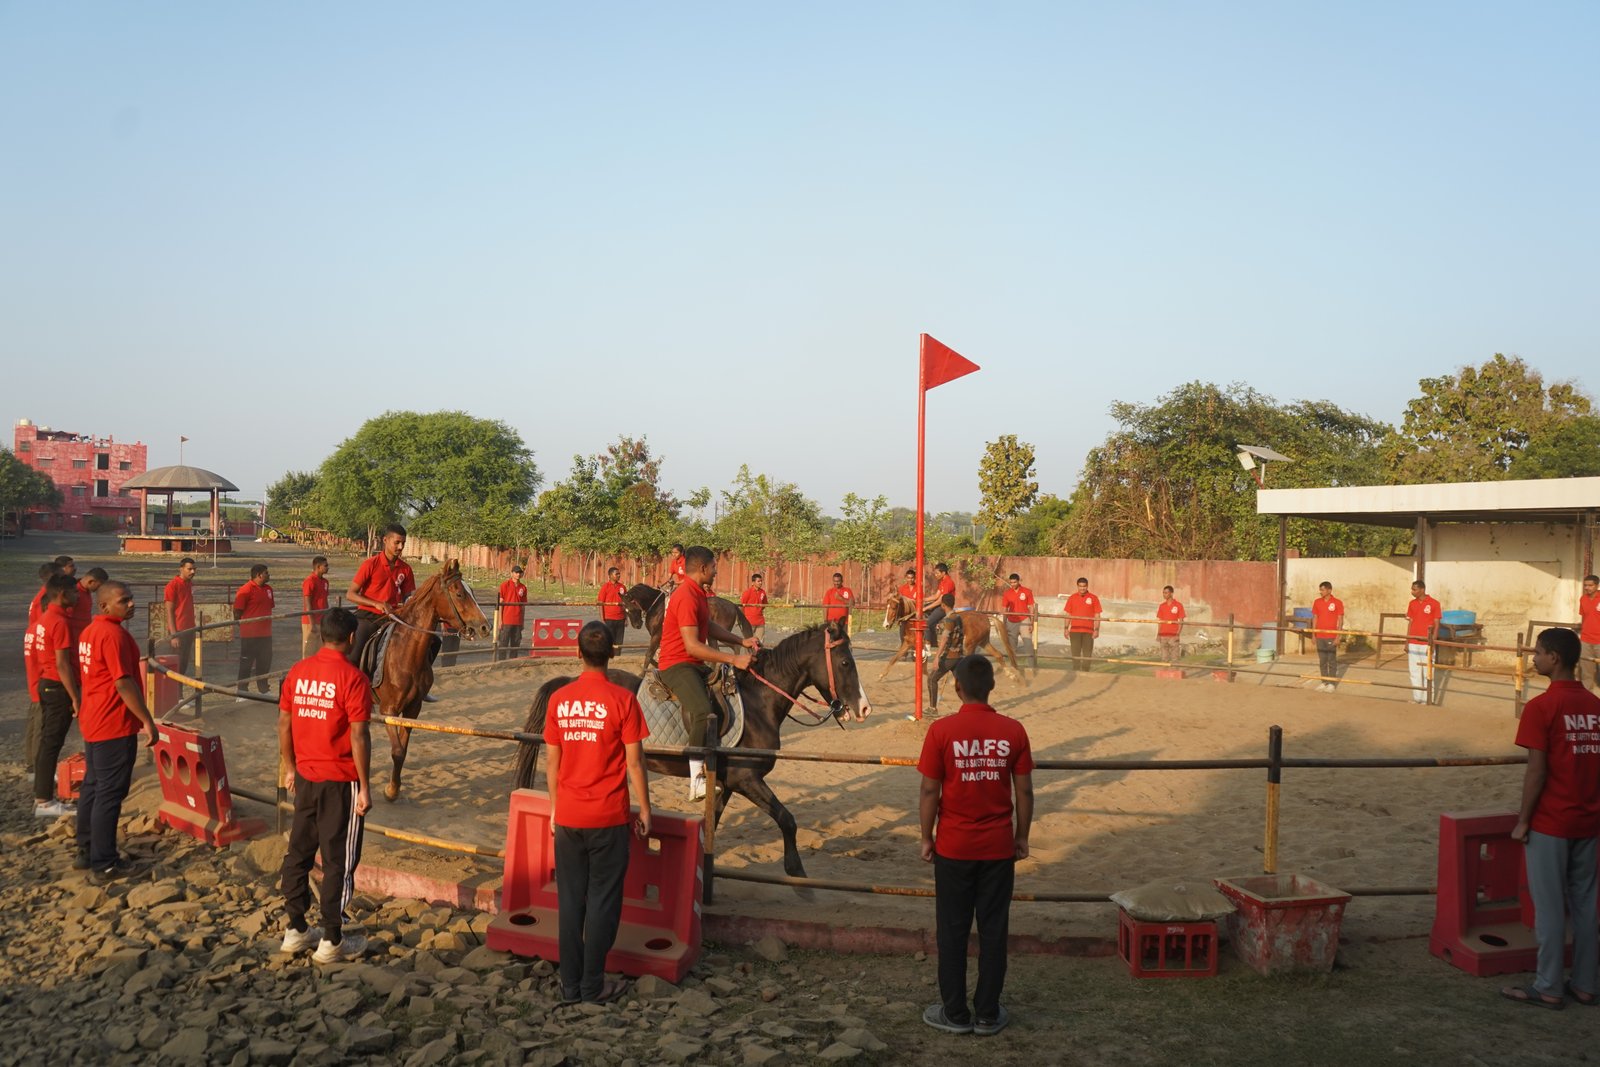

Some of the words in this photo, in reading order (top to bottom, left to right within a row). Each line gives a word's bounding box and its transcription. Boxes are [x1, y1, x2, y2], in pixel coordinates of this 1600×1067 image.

[295, 678, 336, 699] NAFS
[557, 700, 608, 719] NAFS
[953, 739, 1010, 757] NAFS
[962, 770, 1000, 782] NAGPUR
